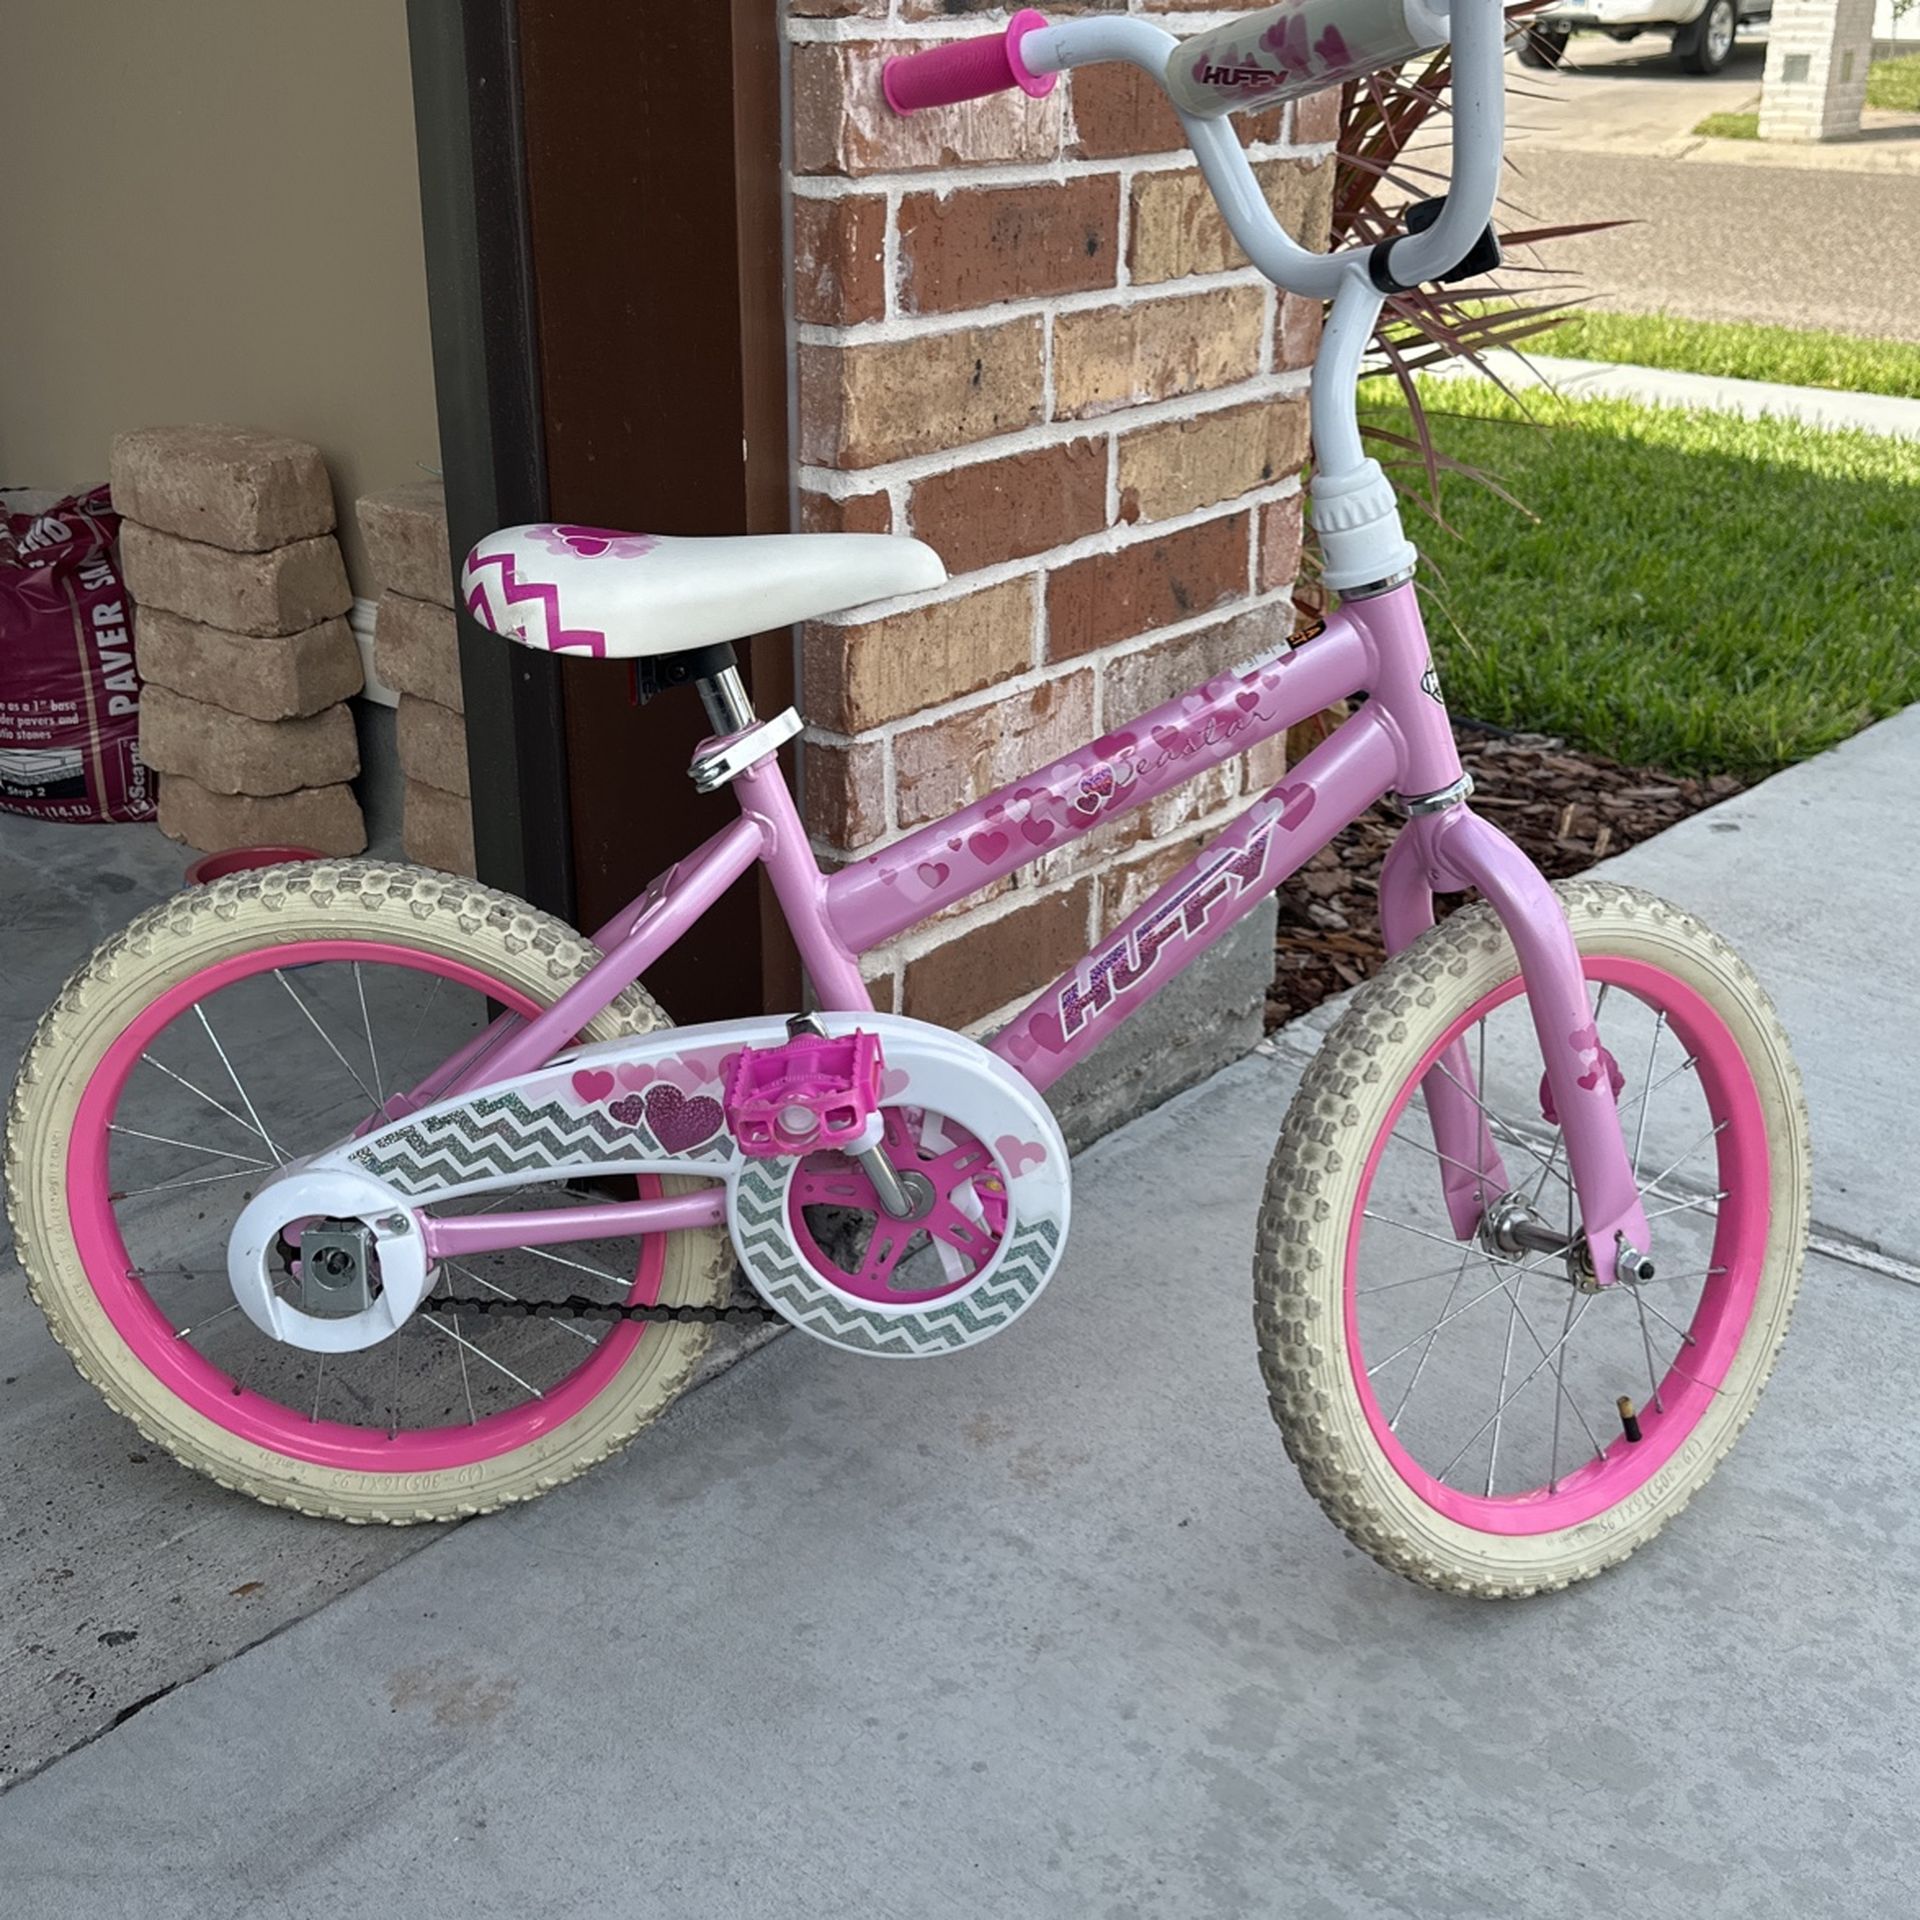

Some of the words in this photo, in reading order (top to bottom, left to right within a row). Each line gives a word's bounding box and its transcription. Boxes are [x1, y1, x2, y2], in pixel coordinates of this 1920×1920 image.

[1202, 65, 1289, 86] HUFFY
[92, 600, 139, 717] PAVER
[50, 699, 77, 711] base
[17, 717, 55, 729] pavers
[58, 712, 79, 725] and
[16, 730, 52, 740] stones
[7, 786, 33, 798] Step
[36, 787, 46, 797] 2
[1058, 814, 1278, 1041] HUFFY
